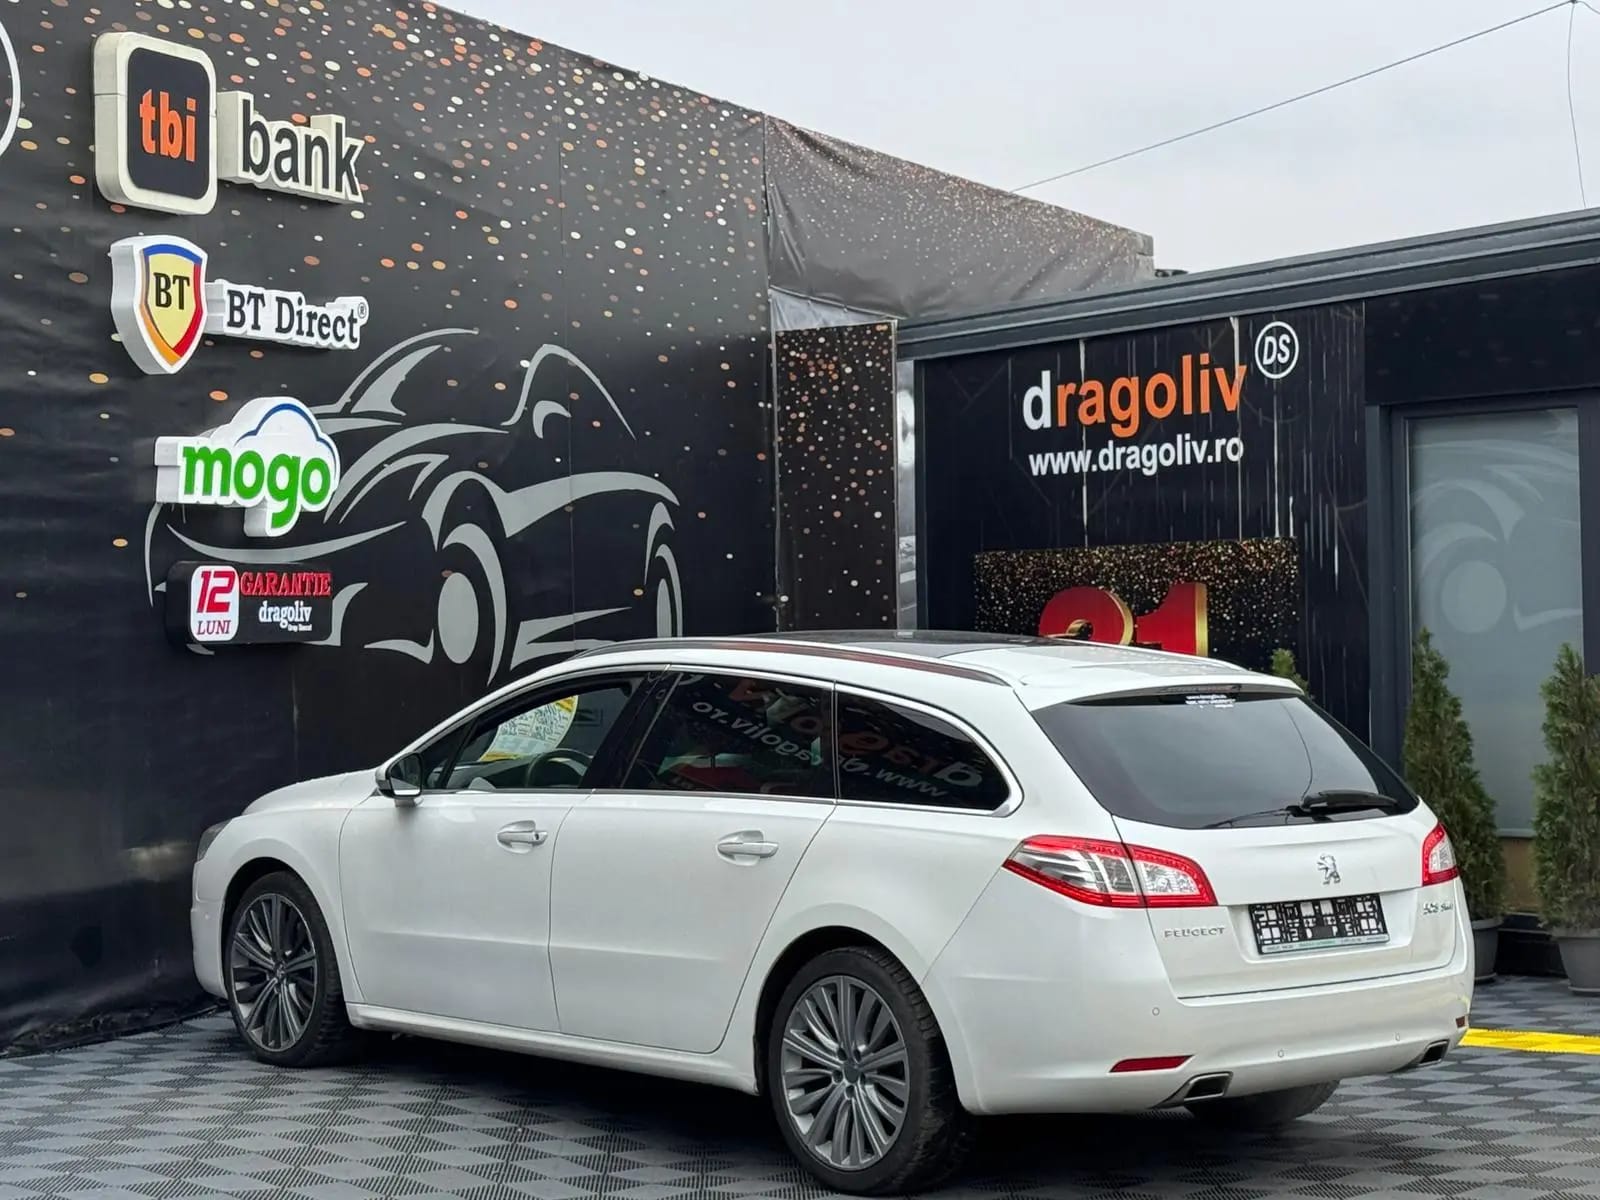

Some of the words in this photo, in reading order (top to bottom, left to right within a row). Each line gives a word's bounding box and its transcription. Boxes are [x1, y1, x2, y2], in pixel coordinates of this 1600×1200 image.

[139, 89, 197, 162] tbi
[241, 98, 363, 196] bank
[154, 272, 190, 311] BT
[226, 289, 266, 331] BT
[1262, 332, 1291, 366] DS
[1022, 352, 1248, 438] dragoliv
[1029, 433, 1244, 476] www.dragoliv.ro
[182, 445, 331, 529] mogo
[196, 570, 236, 613] 12
[240, 571, 331, 596] GARANTIE
[196, 620, 231, 636] LUNI
[258, 600, 312, 629] dragoliv
